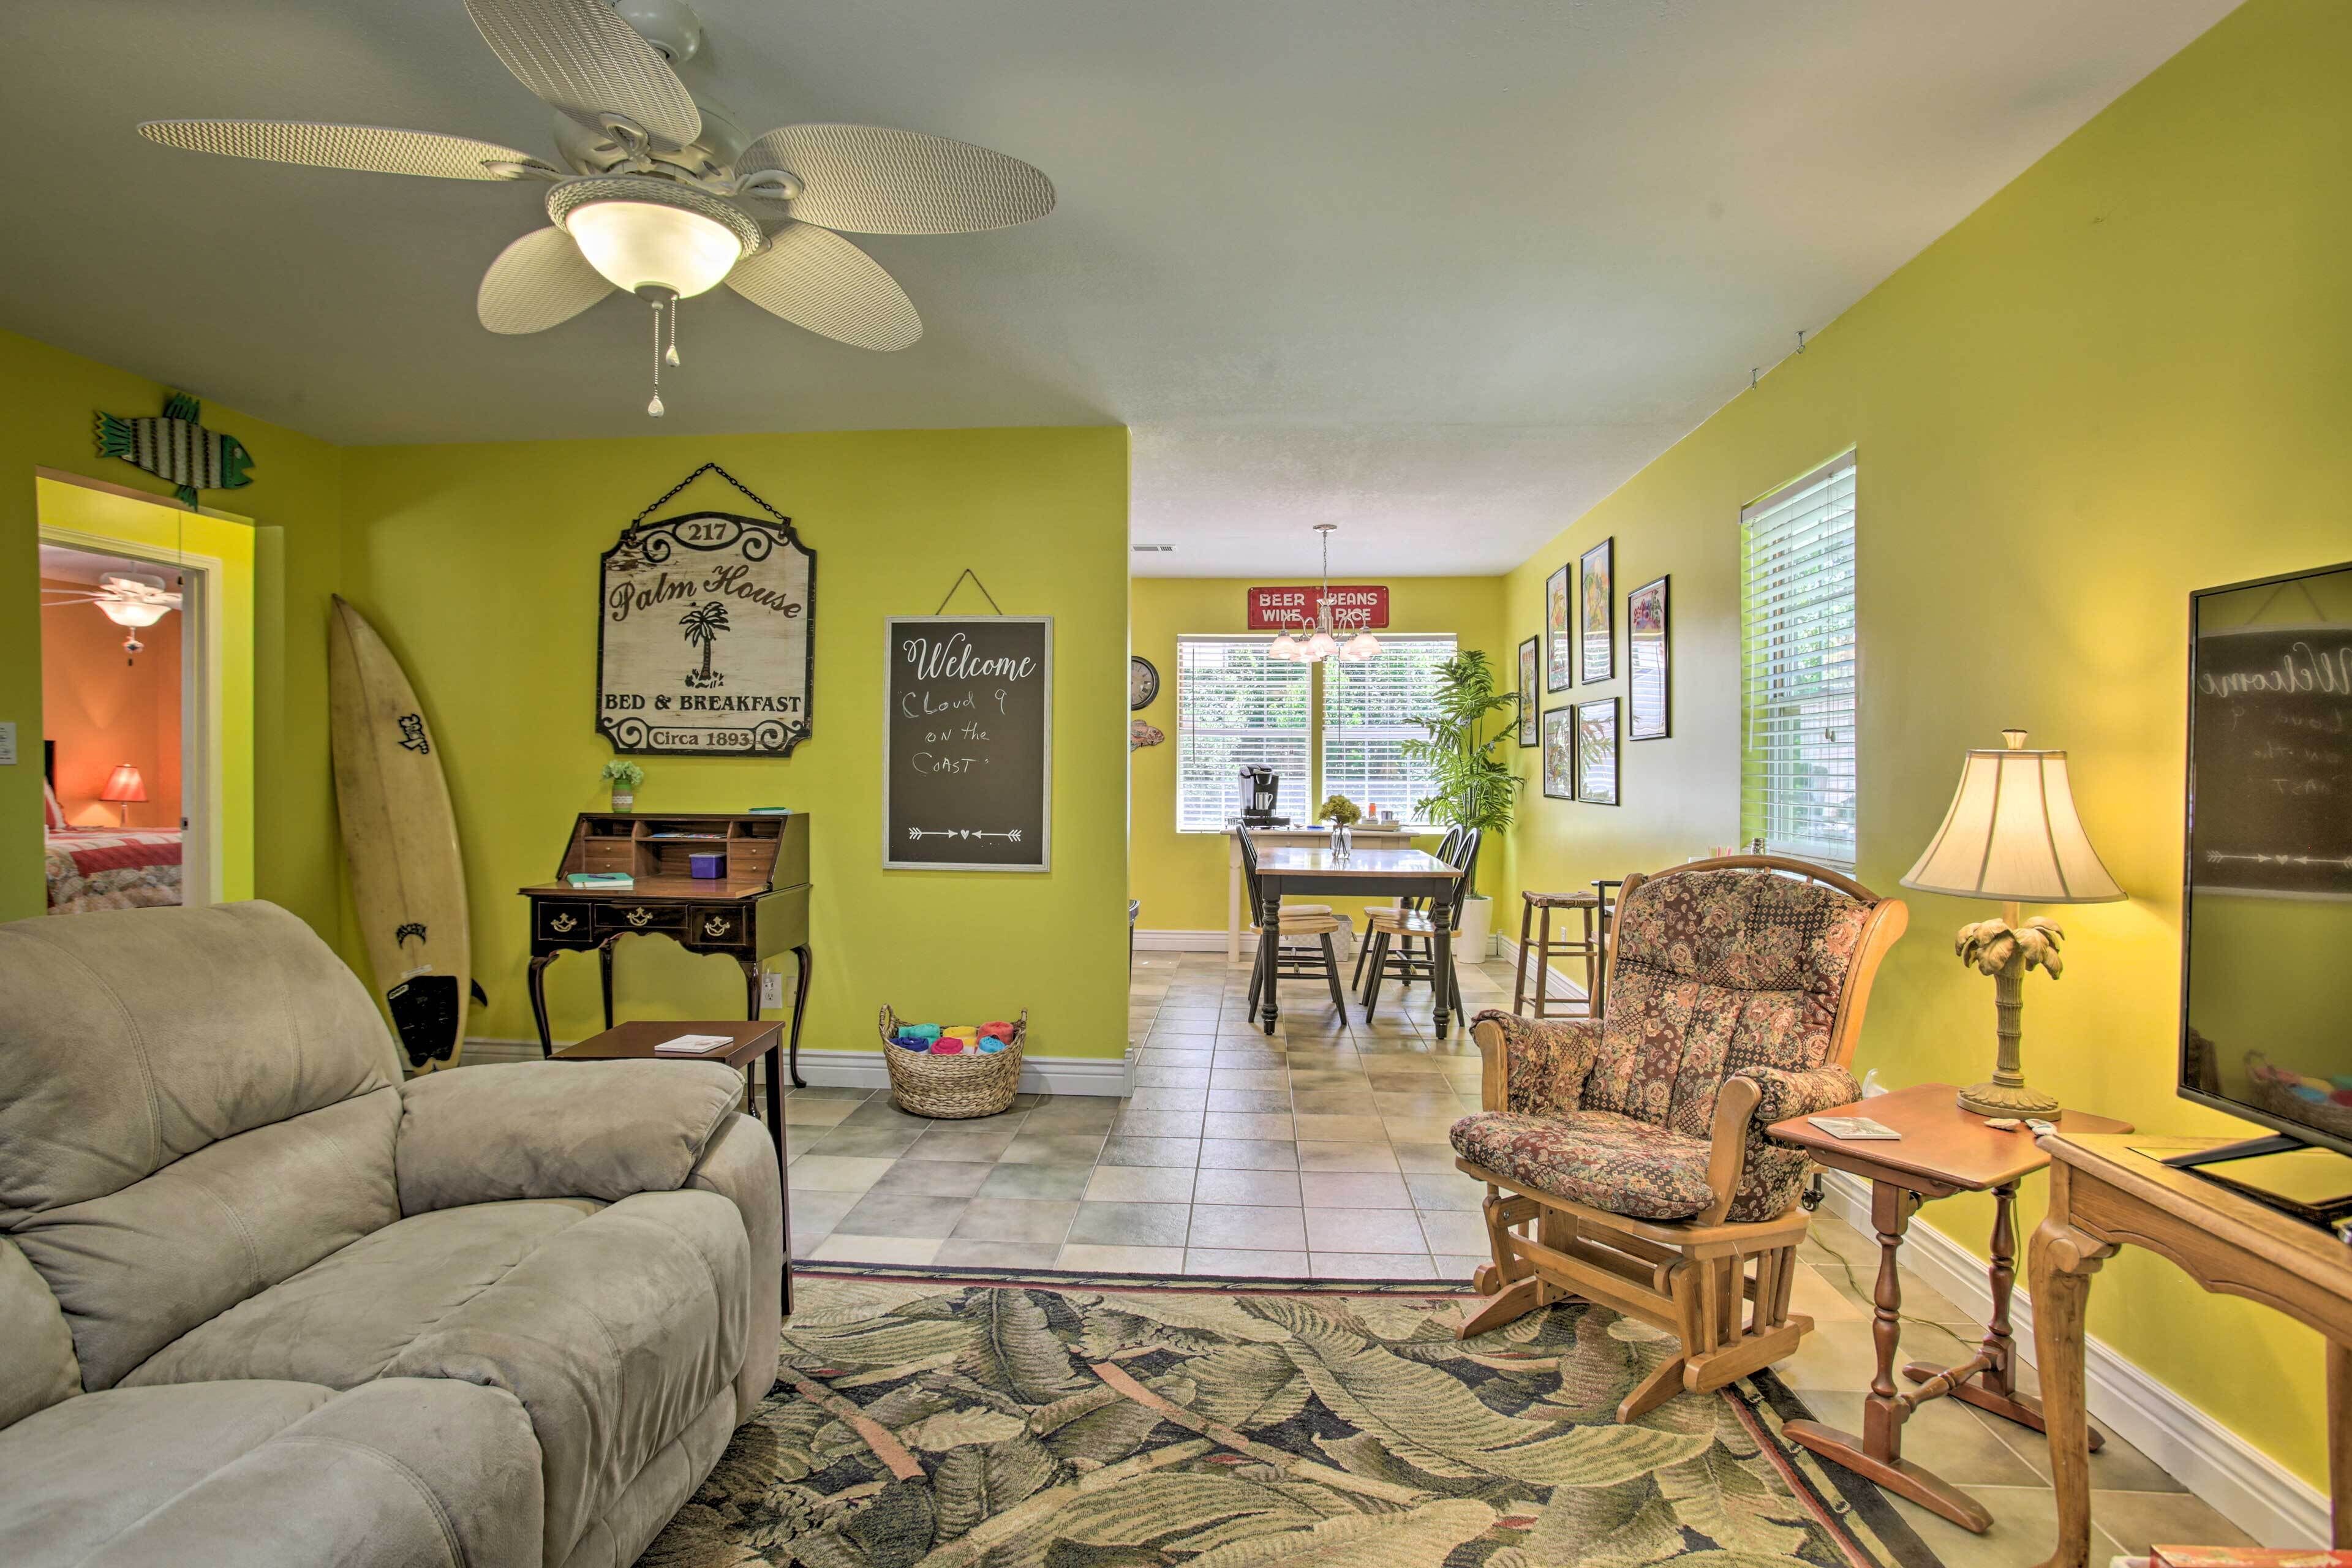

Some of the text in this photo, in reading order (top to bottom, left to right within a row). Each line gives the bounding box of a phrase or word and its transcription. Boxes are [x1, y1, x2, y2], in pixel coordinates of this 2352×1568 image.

[688, 522, 727, 541] 217
[609, 564, 802, 622] Palm House
[1259, 592, 1378, 606] BEER BEANS
[1262, 609, 1301, 622] WINE
[903, 633, 1037, 682] Welcome
[605, 695, 801, 712] BED & BREAKFAST
[995, 689, 1008, 715] 9
[652, 731, 750, 745] Circa 1893
[961, 721, 990, 741] the
